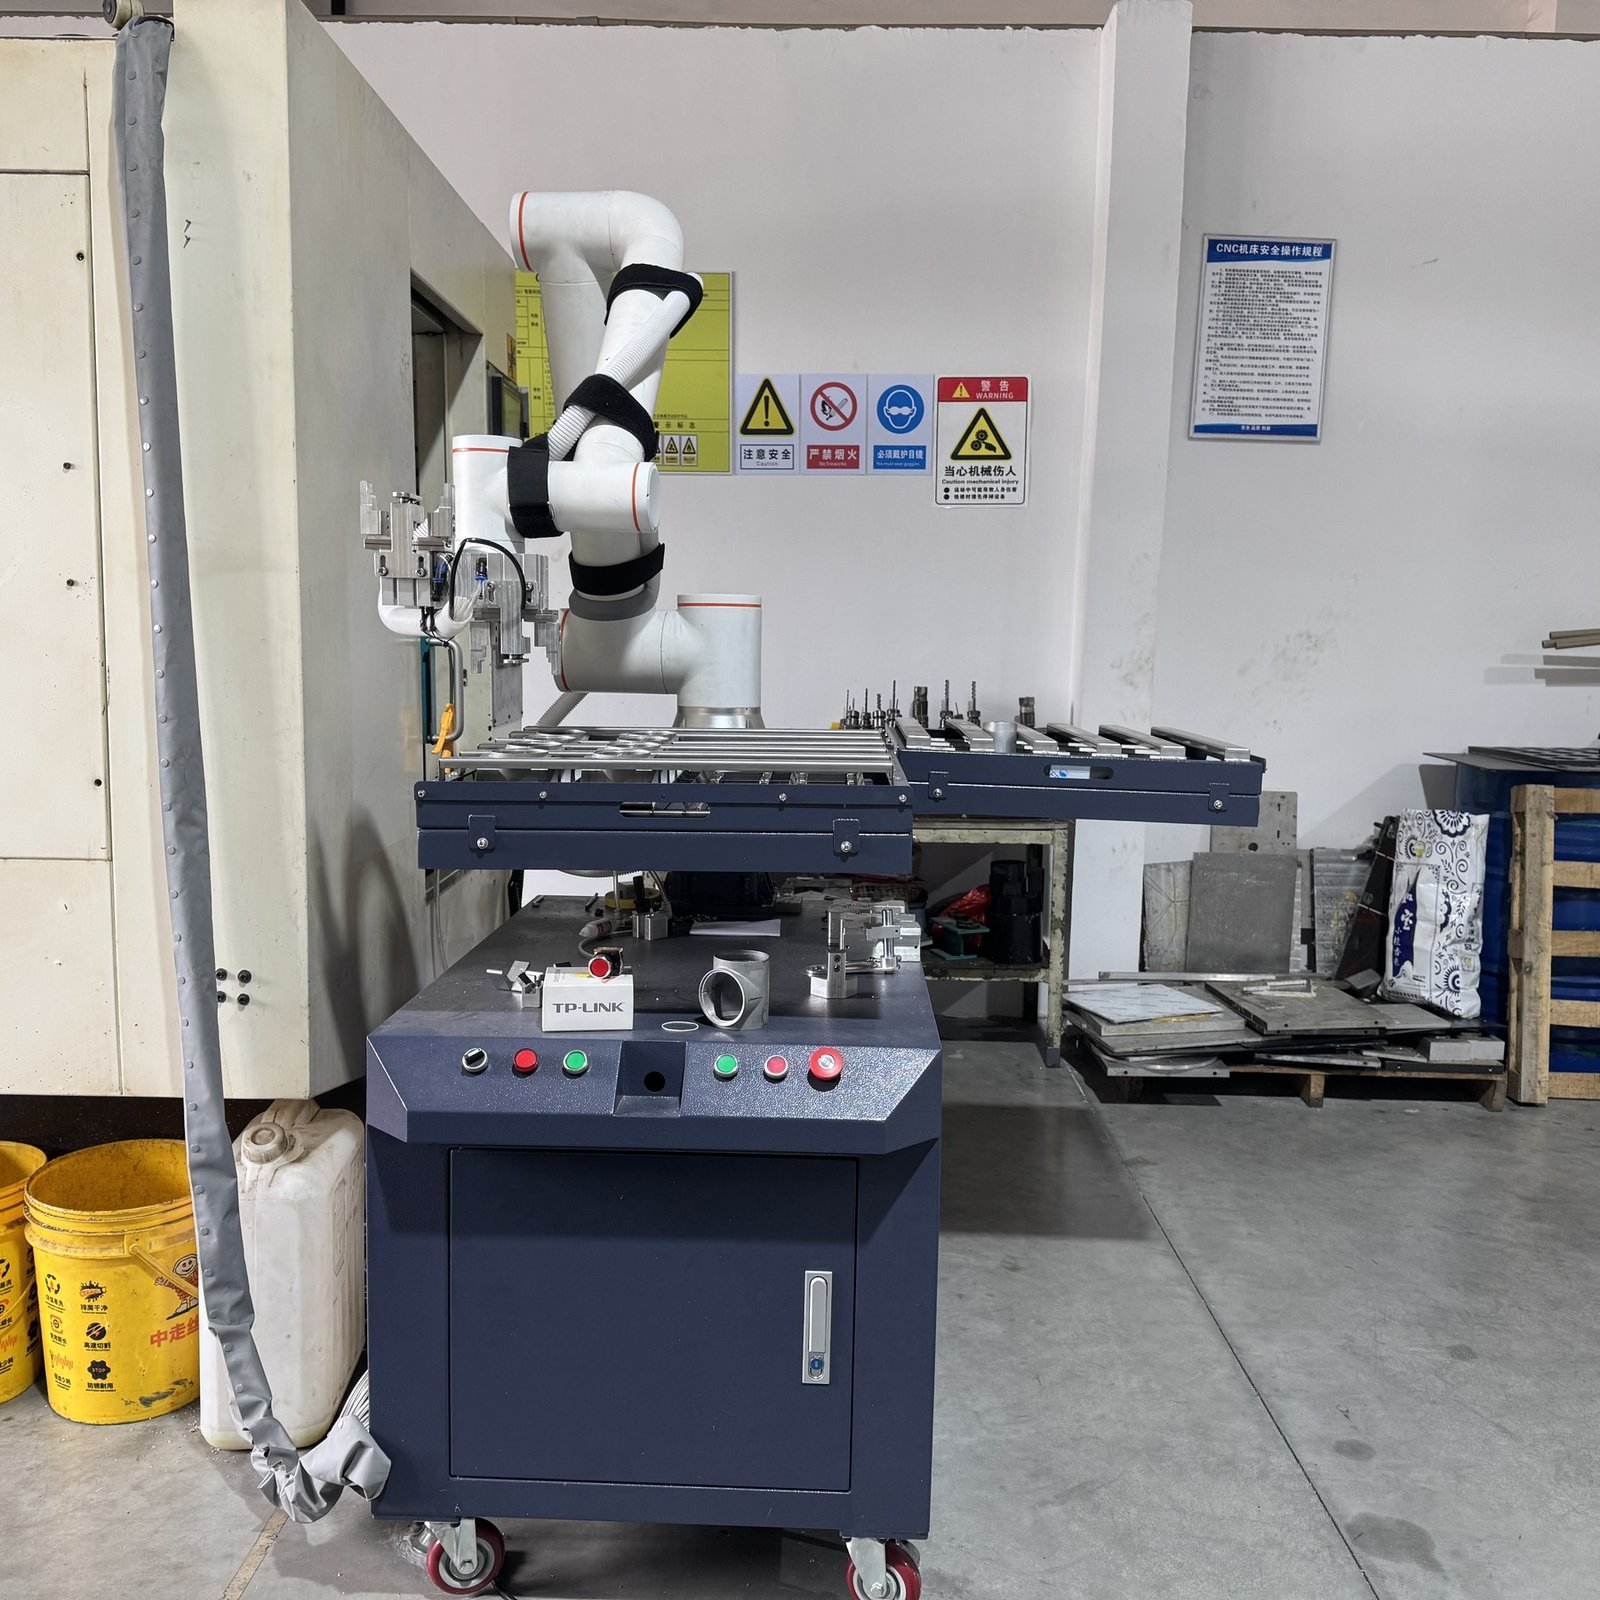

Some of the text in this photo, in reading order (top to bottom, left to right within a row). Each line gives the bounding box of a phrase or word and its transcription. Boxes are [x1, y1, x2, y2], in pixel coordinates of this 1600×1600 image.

[1216, 243, 1324, 257] CNC机床安全操作规程
[981, 380, 1009, 392] 警告
[976, 392, 1014, 400] WARNING
[743, 448, 791, 460] 注意安全
[809, 448, 857, 461] 严禁烟火
[944, 465, 1017, 477] 当心机械伤人
[552, 1002, 624, 1014] TP-LINK
